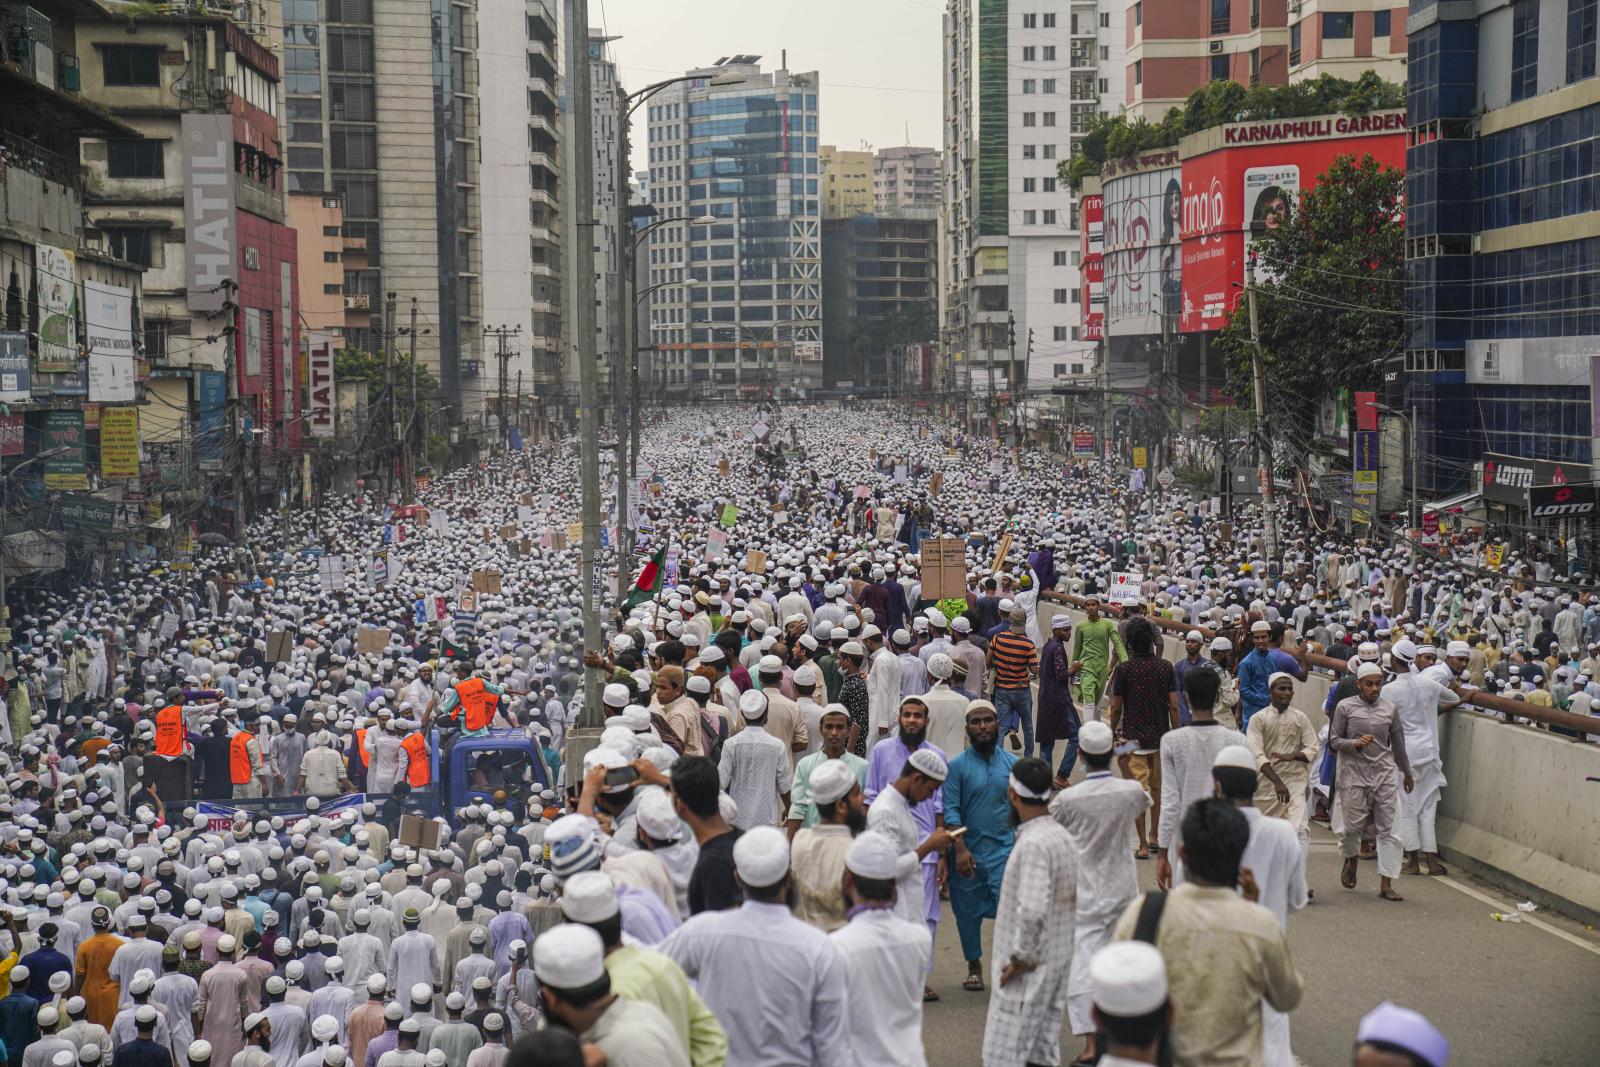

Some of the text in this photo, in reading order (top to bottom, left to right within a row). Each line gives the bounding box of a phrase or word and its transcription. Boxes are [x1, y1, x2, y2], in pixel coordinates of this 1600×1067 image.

[1225, 113, 1406, 143] KARNAPHULI GARDEN
[192, 140, 230, 286] HATIL
[1088, 197, 1102, 209] rin
[312, 341, 331, 425] HATIL
[1495, 464, 1534, 488] LOTTO
[1533, 501, 1595, 517] LOTTO
